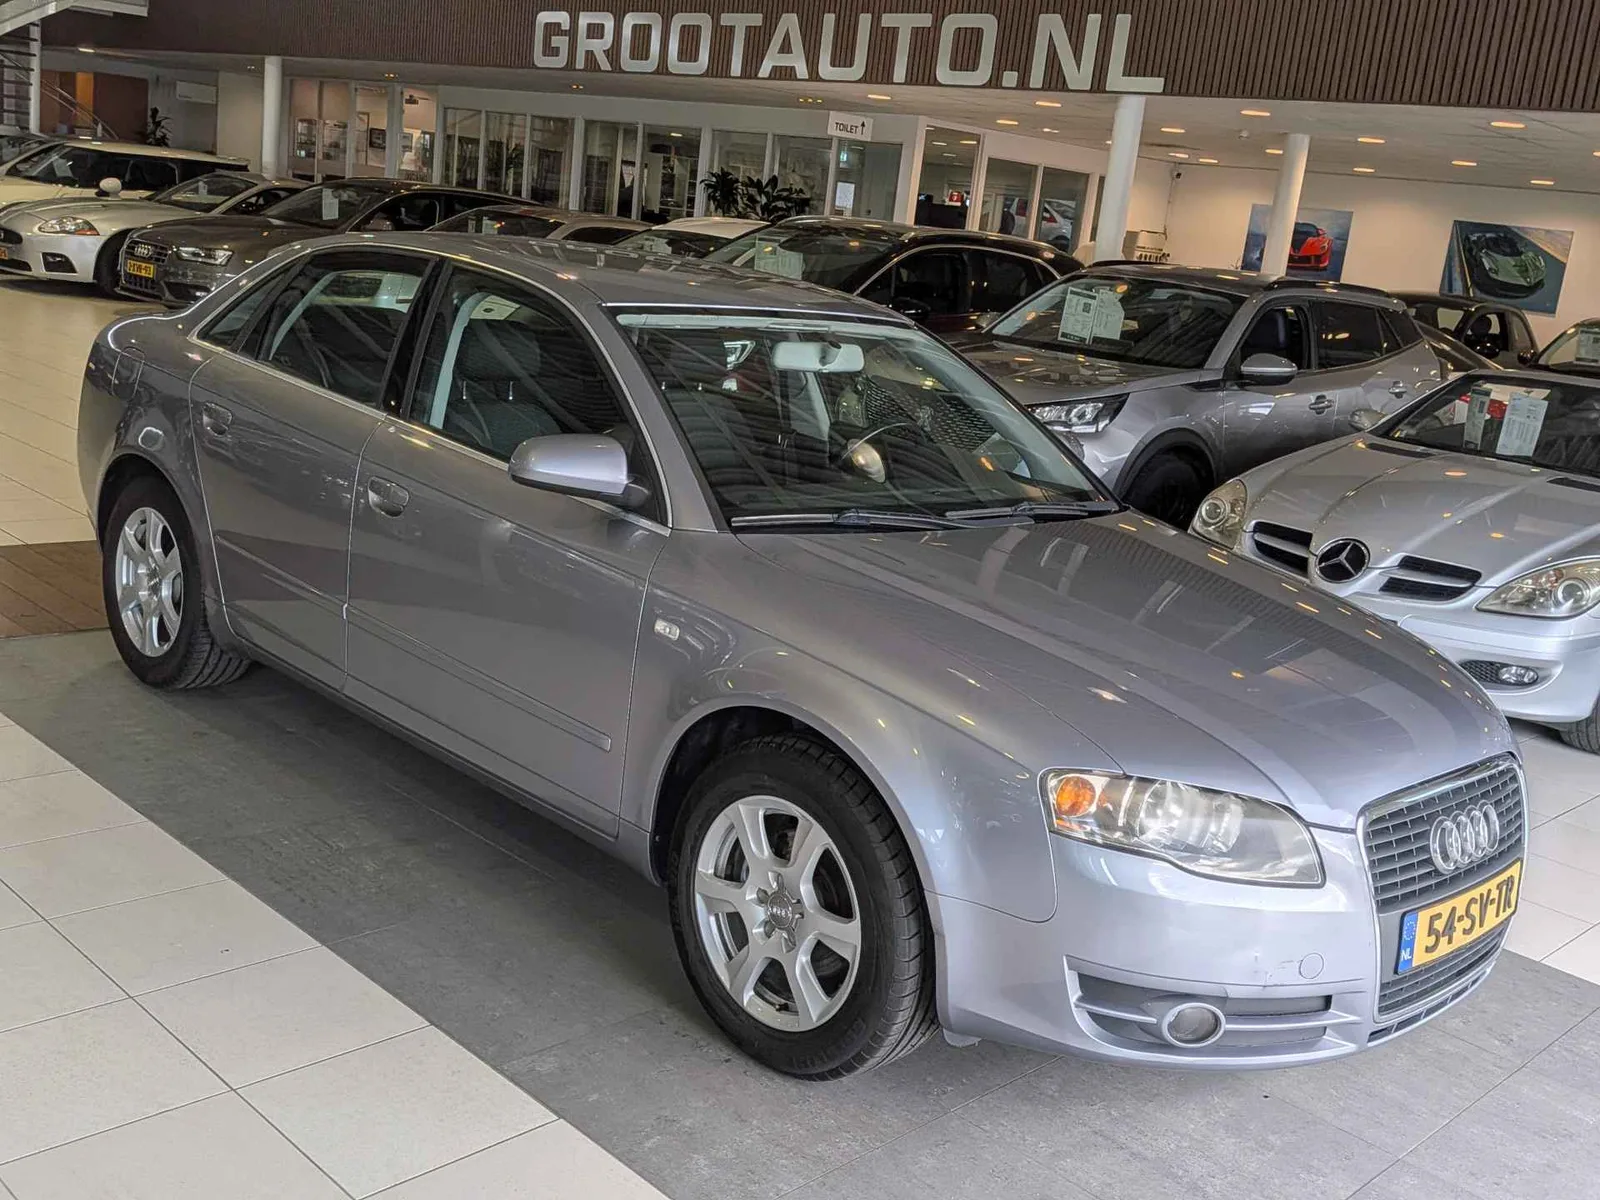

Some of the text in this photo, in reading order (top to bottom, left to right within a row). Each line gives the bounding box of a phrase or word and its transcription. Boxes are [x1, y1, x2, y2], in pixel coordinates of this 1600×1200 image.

[533, 11, 1165, 92] GROOTAUTO.NL
[835, 121, 859, 134] TOILET
[1425, 875, 1515, 954] 54-SV-TR
[1401, 947, 1412, 961] NL
